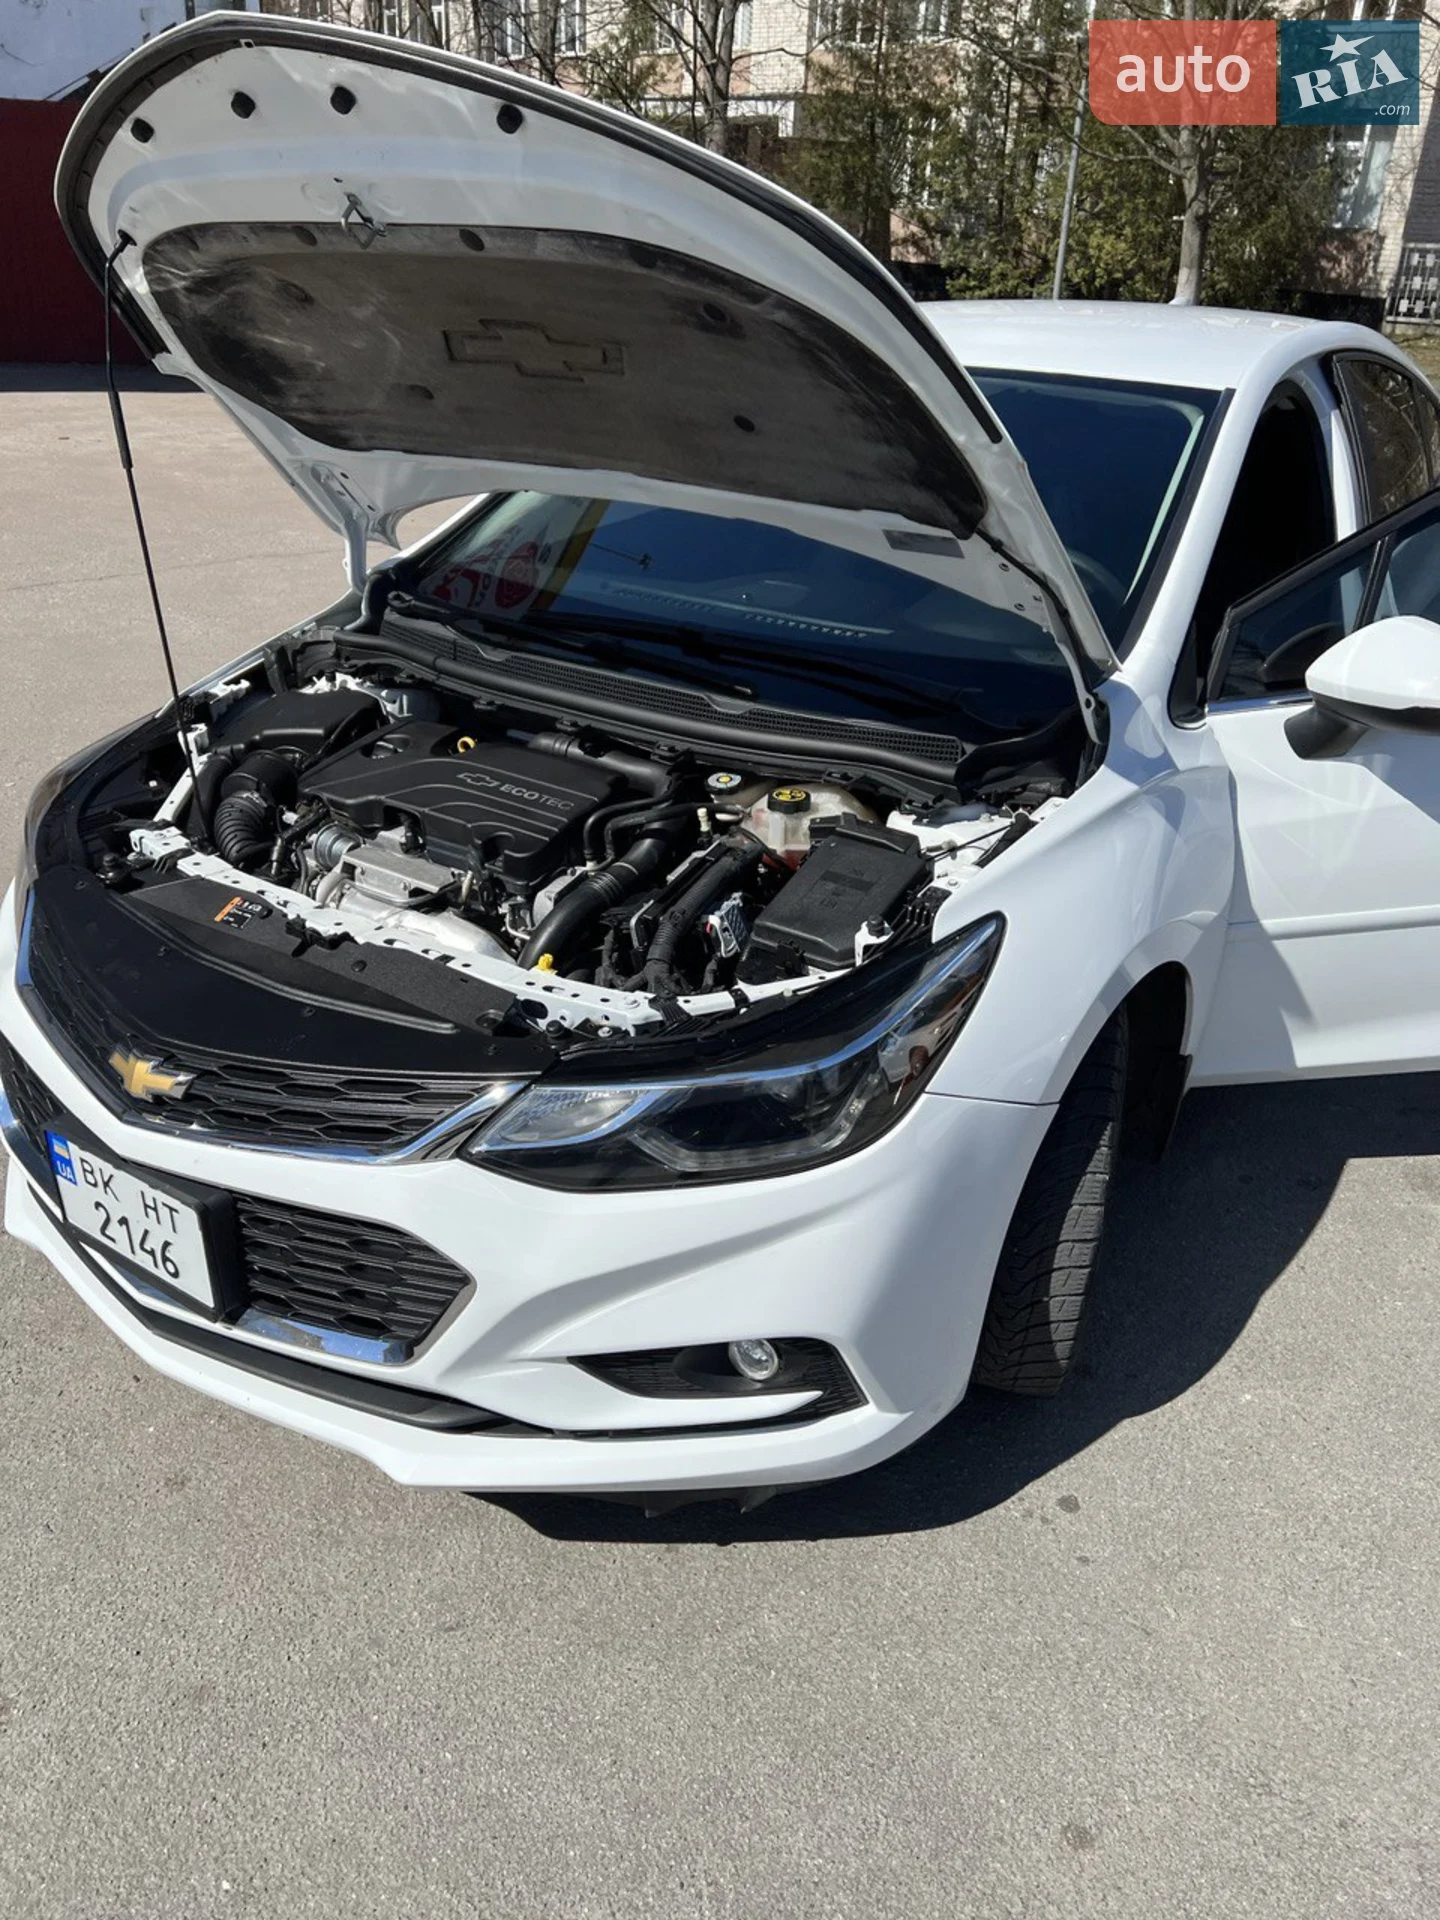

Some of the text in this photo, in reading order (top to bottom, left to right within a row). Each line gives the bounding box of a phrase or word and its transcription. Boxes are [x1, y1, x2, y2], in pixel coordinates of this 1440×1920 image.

[499, 783, 575, 810] ECOTEC
[56, 1160, 75, 1184] UA
[79, 1156, 180, 1234] BK HT
[94, 1200, 180, 1279] 2146
